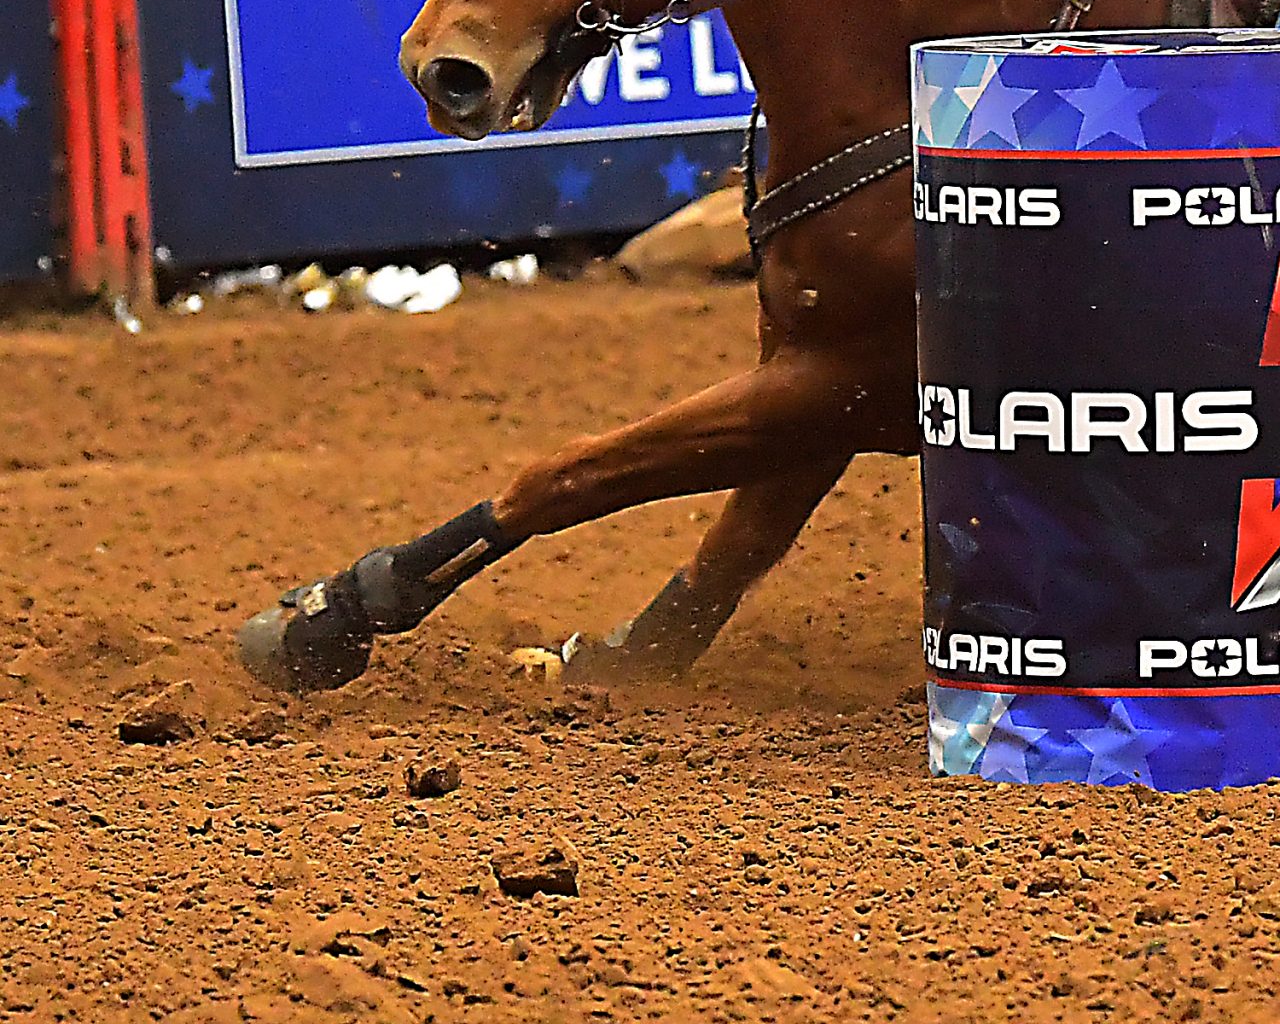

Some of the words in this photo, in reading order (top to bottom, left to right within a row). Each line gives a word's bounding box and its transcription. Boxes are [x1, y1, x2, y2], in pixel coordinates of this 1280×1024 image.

[914, 181, 1061, 226] OLARIS
[917, 382, 1258, 452] OLARIS
[923, 627, 1067, 677] OLARIS
